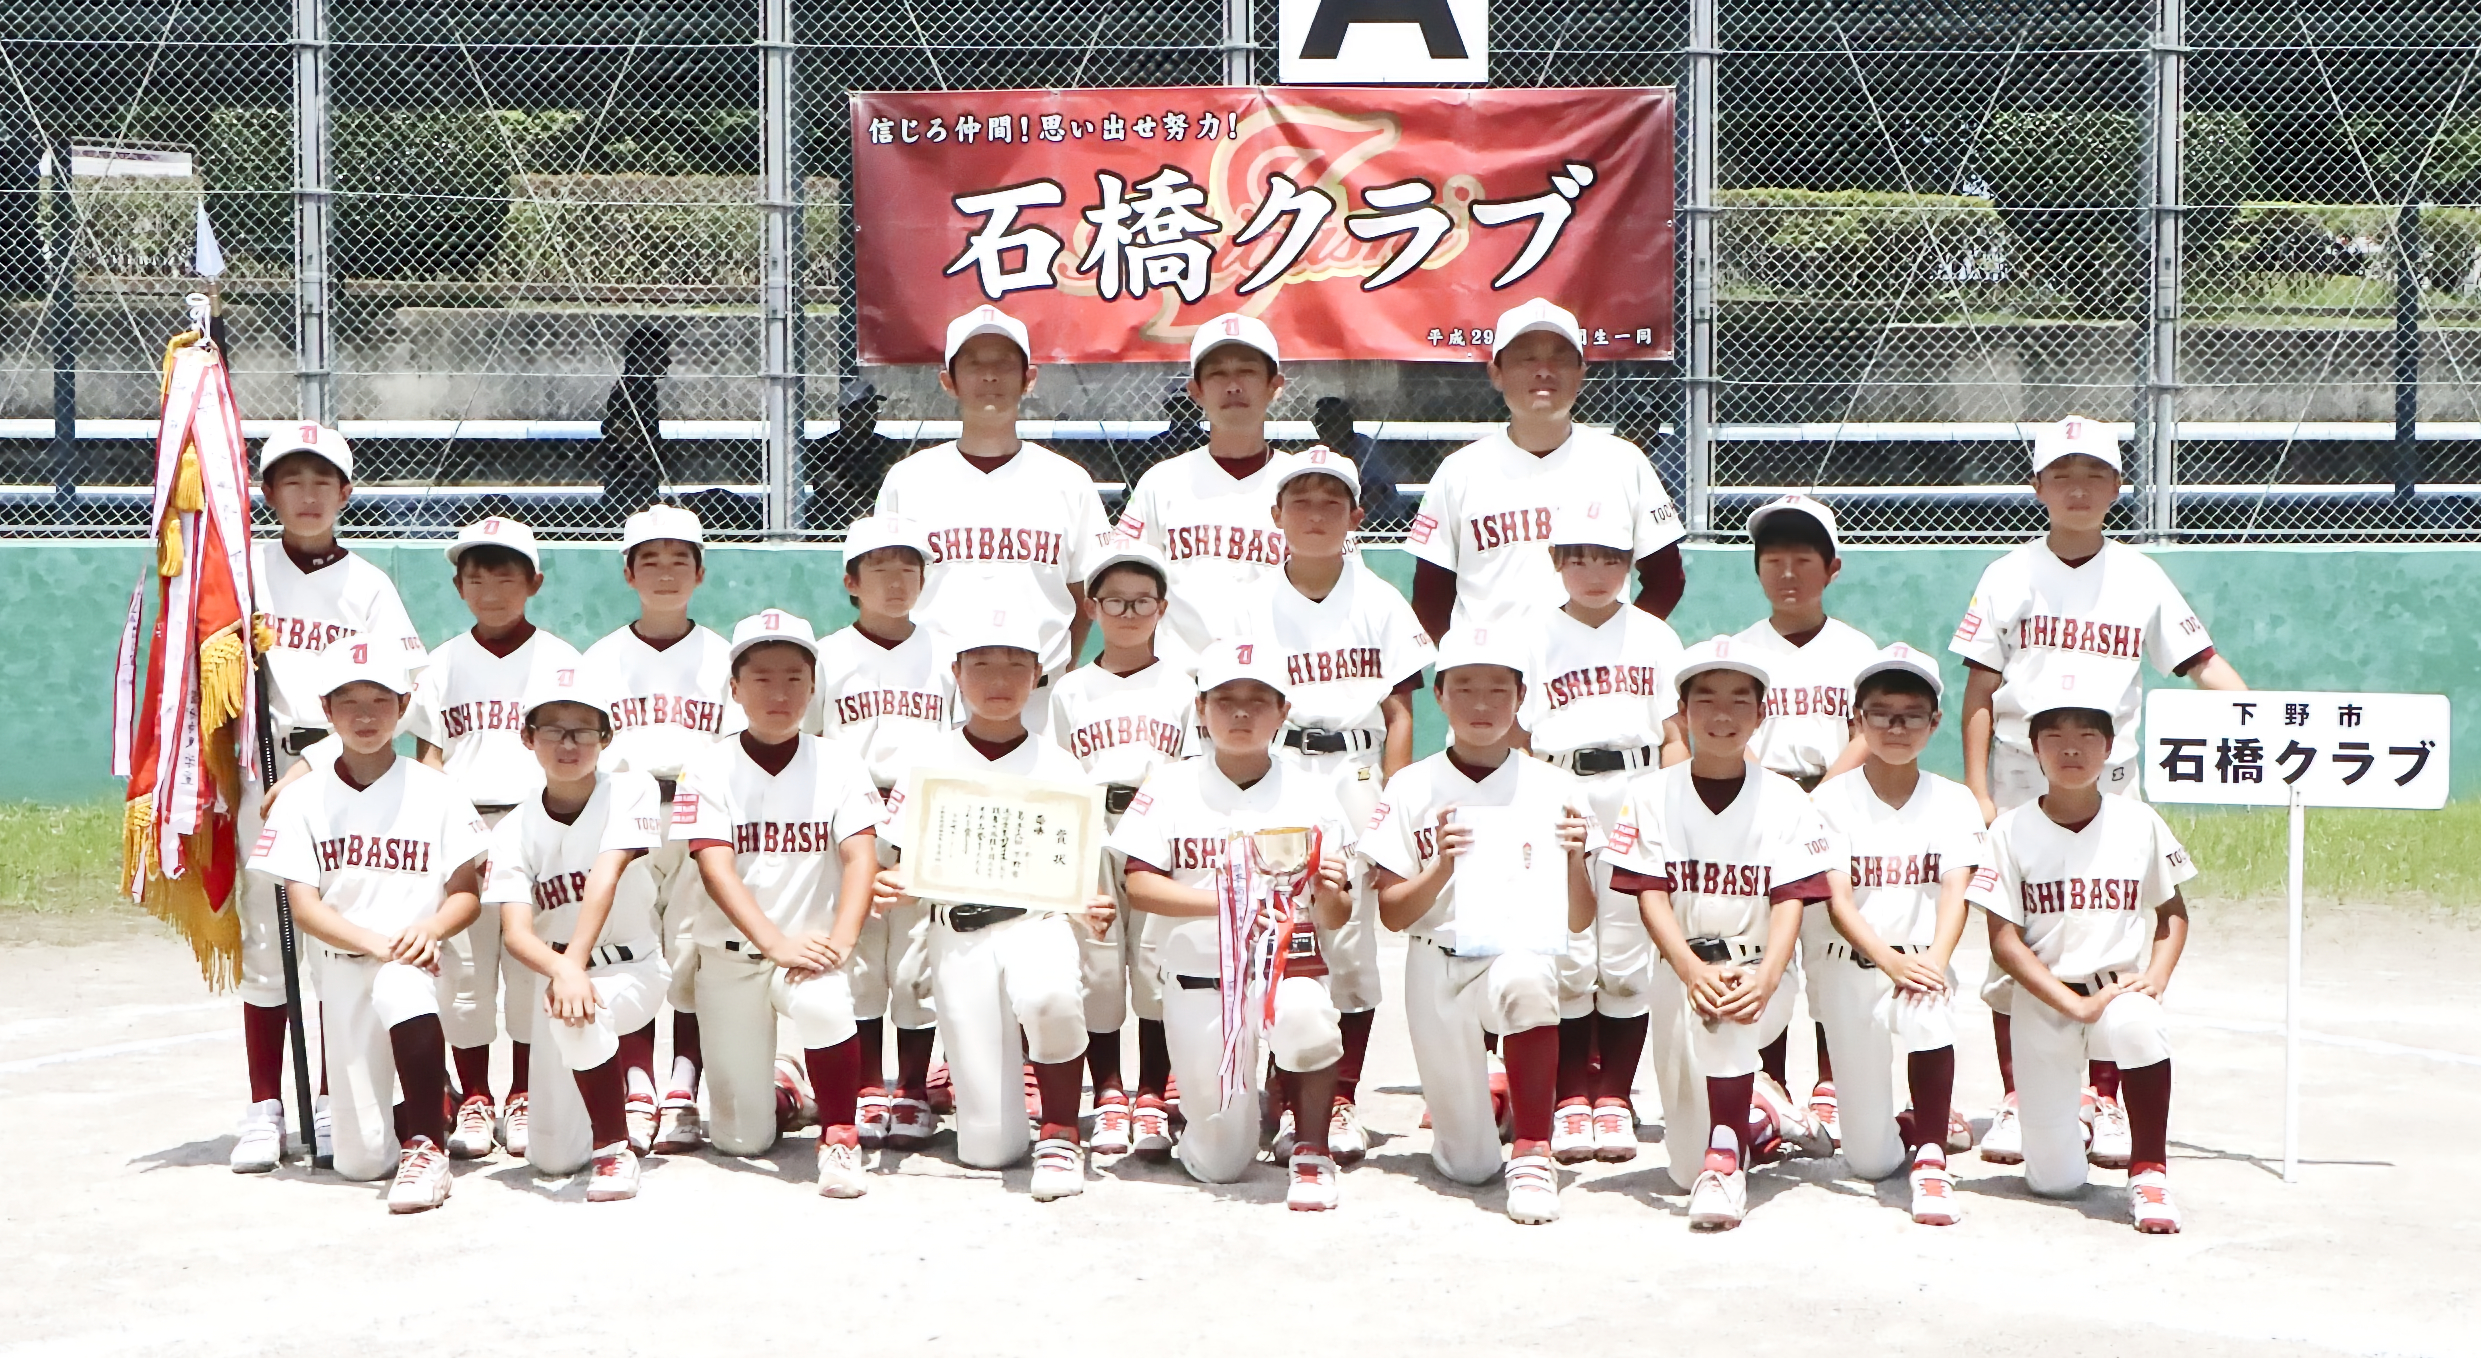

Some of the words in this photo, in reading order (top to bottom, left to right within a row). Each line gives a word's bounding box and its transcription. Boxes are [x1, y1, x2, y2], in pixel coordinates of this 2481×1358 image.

[944, 162, 1596, 302] 石橋クラブ
[926, 528, 1060, 565] SHIBASHI
[1165, 525, 1289, 566] ISHIBAS
[1471, 507, 1551, 552] ISHIB
[441, 701, 525, 738] ISHIBA
[2232, 703, 2363, 727] 下野市
[2159, 738, 2436, 787] 石橋クラブ
